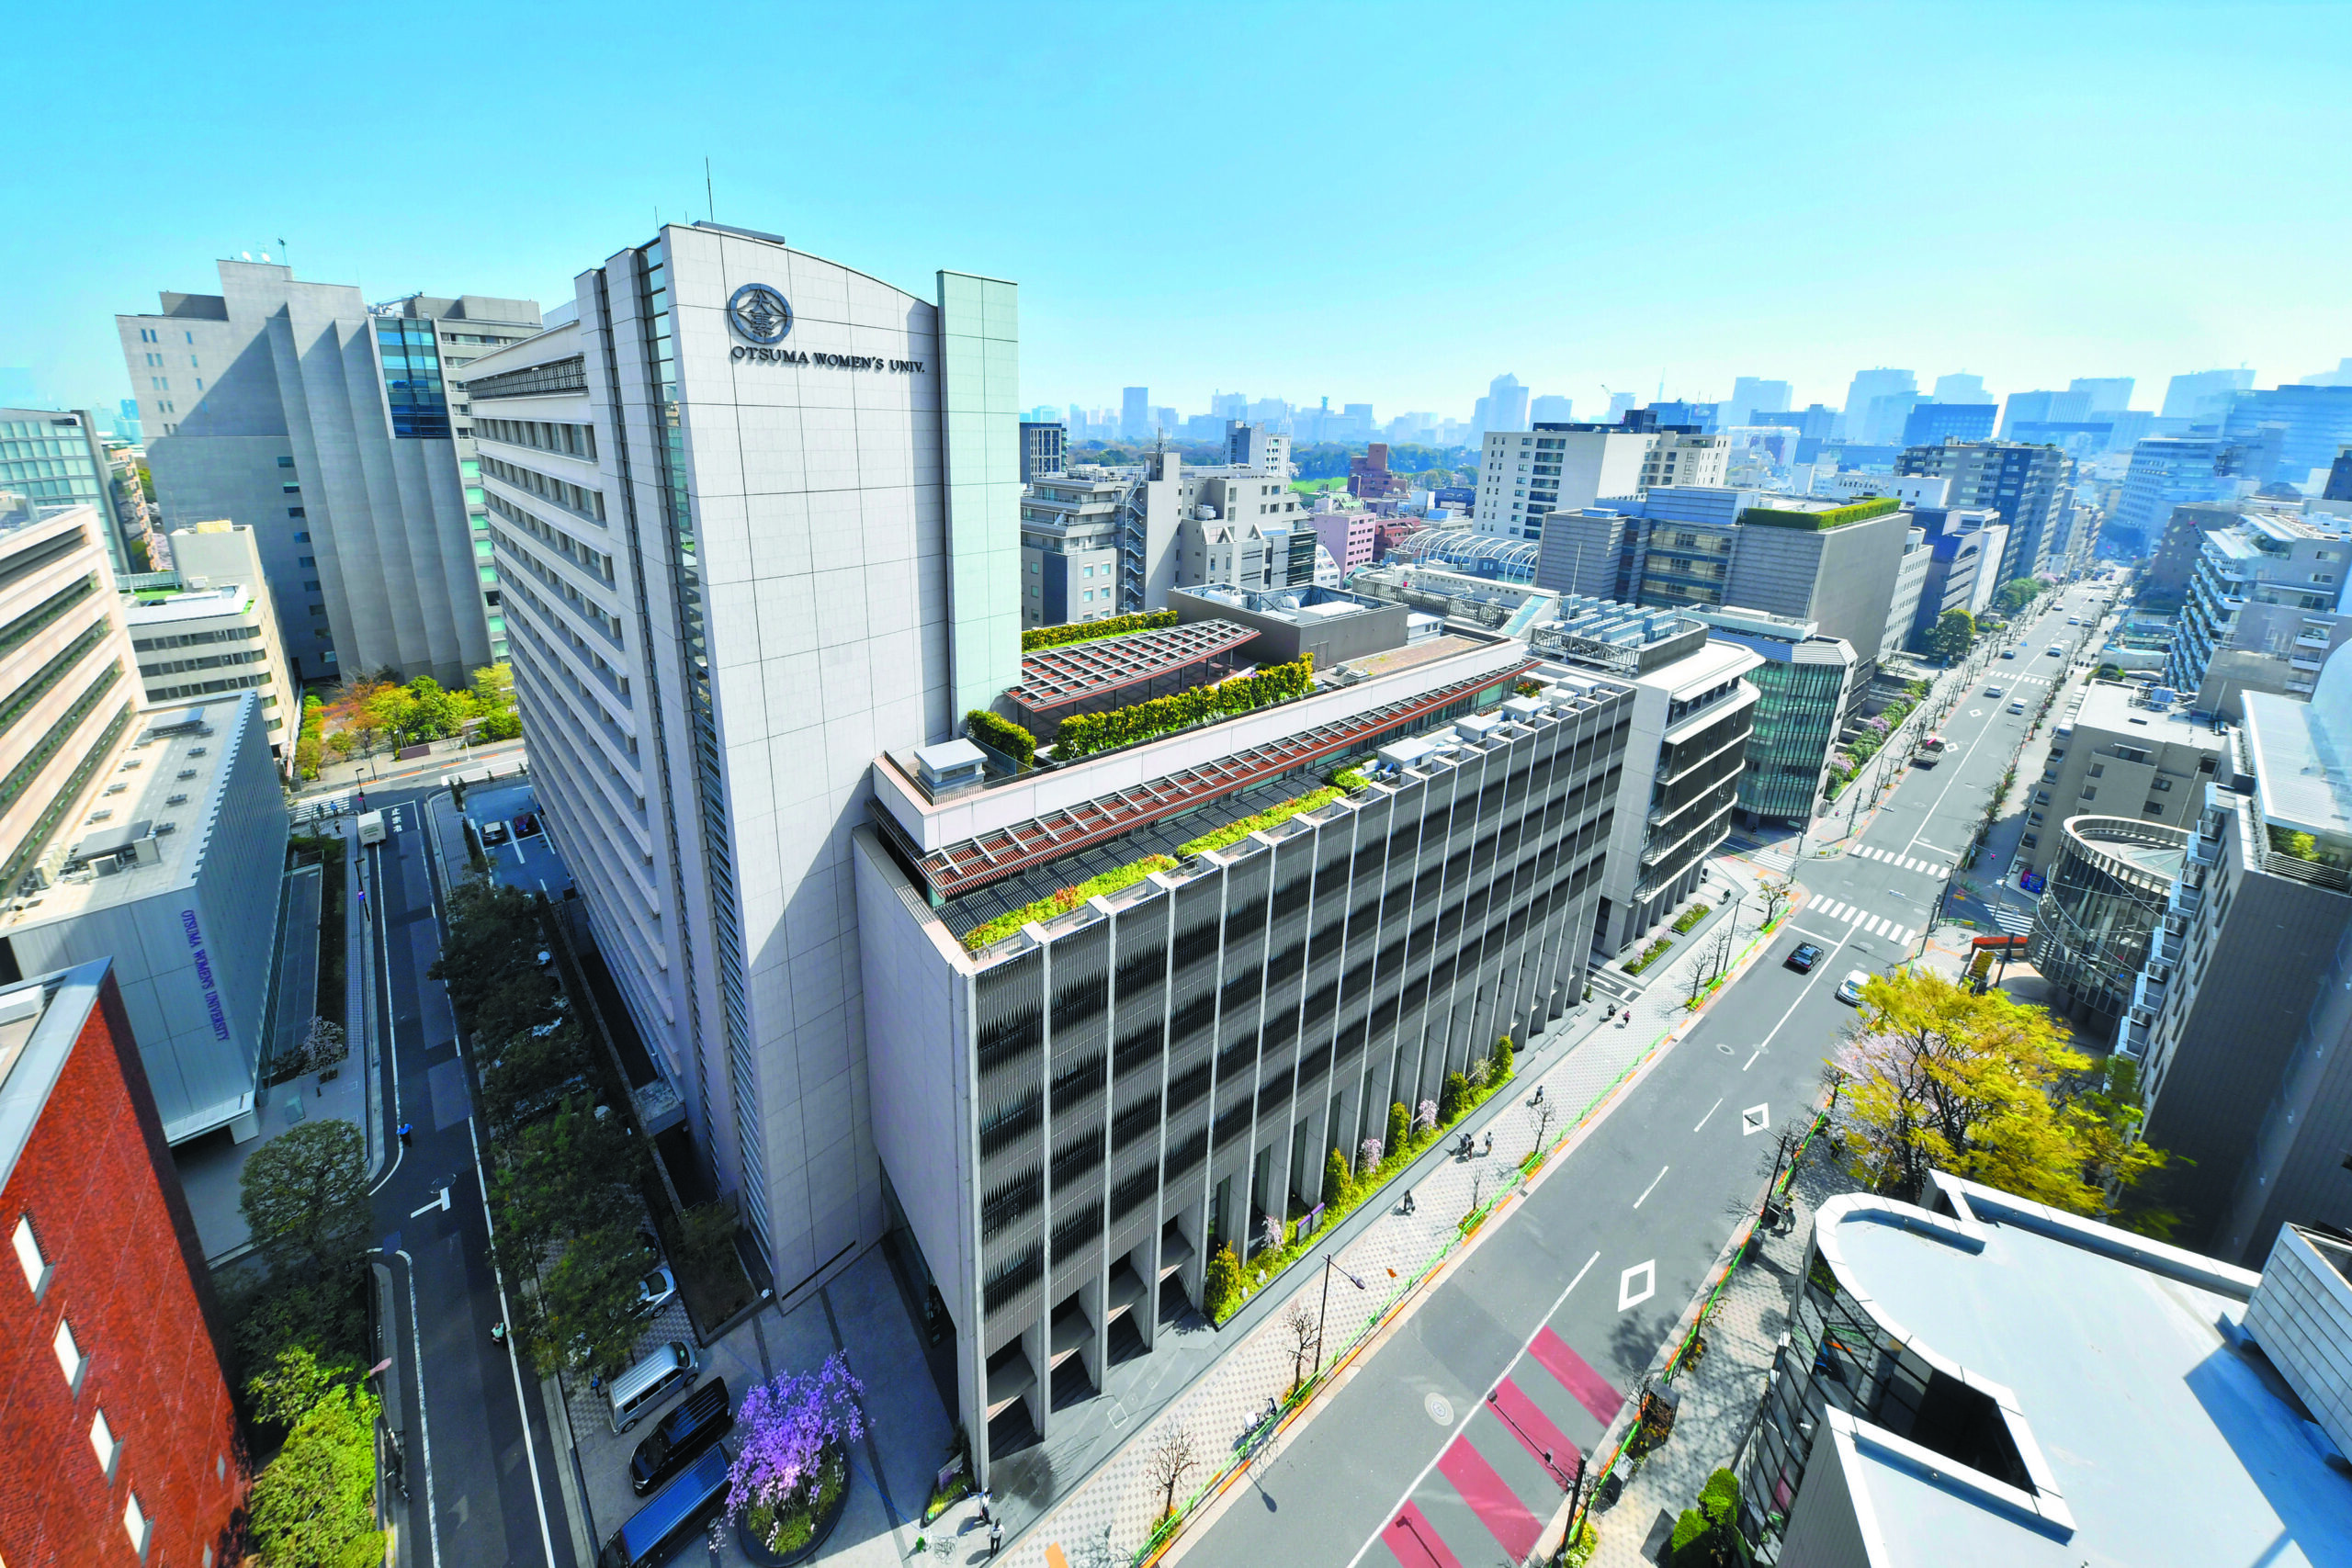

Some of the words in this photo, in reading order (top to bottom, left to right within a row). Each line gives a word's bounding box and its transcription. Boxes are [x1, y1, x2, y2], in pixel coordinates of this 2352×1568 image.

[731, 345, 809, 364] OTSUMA
[814, 352, 885, 369] WOMEN'S
[889, 359, 925, 373] UNIV.
[391, 808, 402, 832] 止まれ
[181, 909, 203, 948] OTSUMA
[205, 990, 230, 1042] UNIVERSITY
